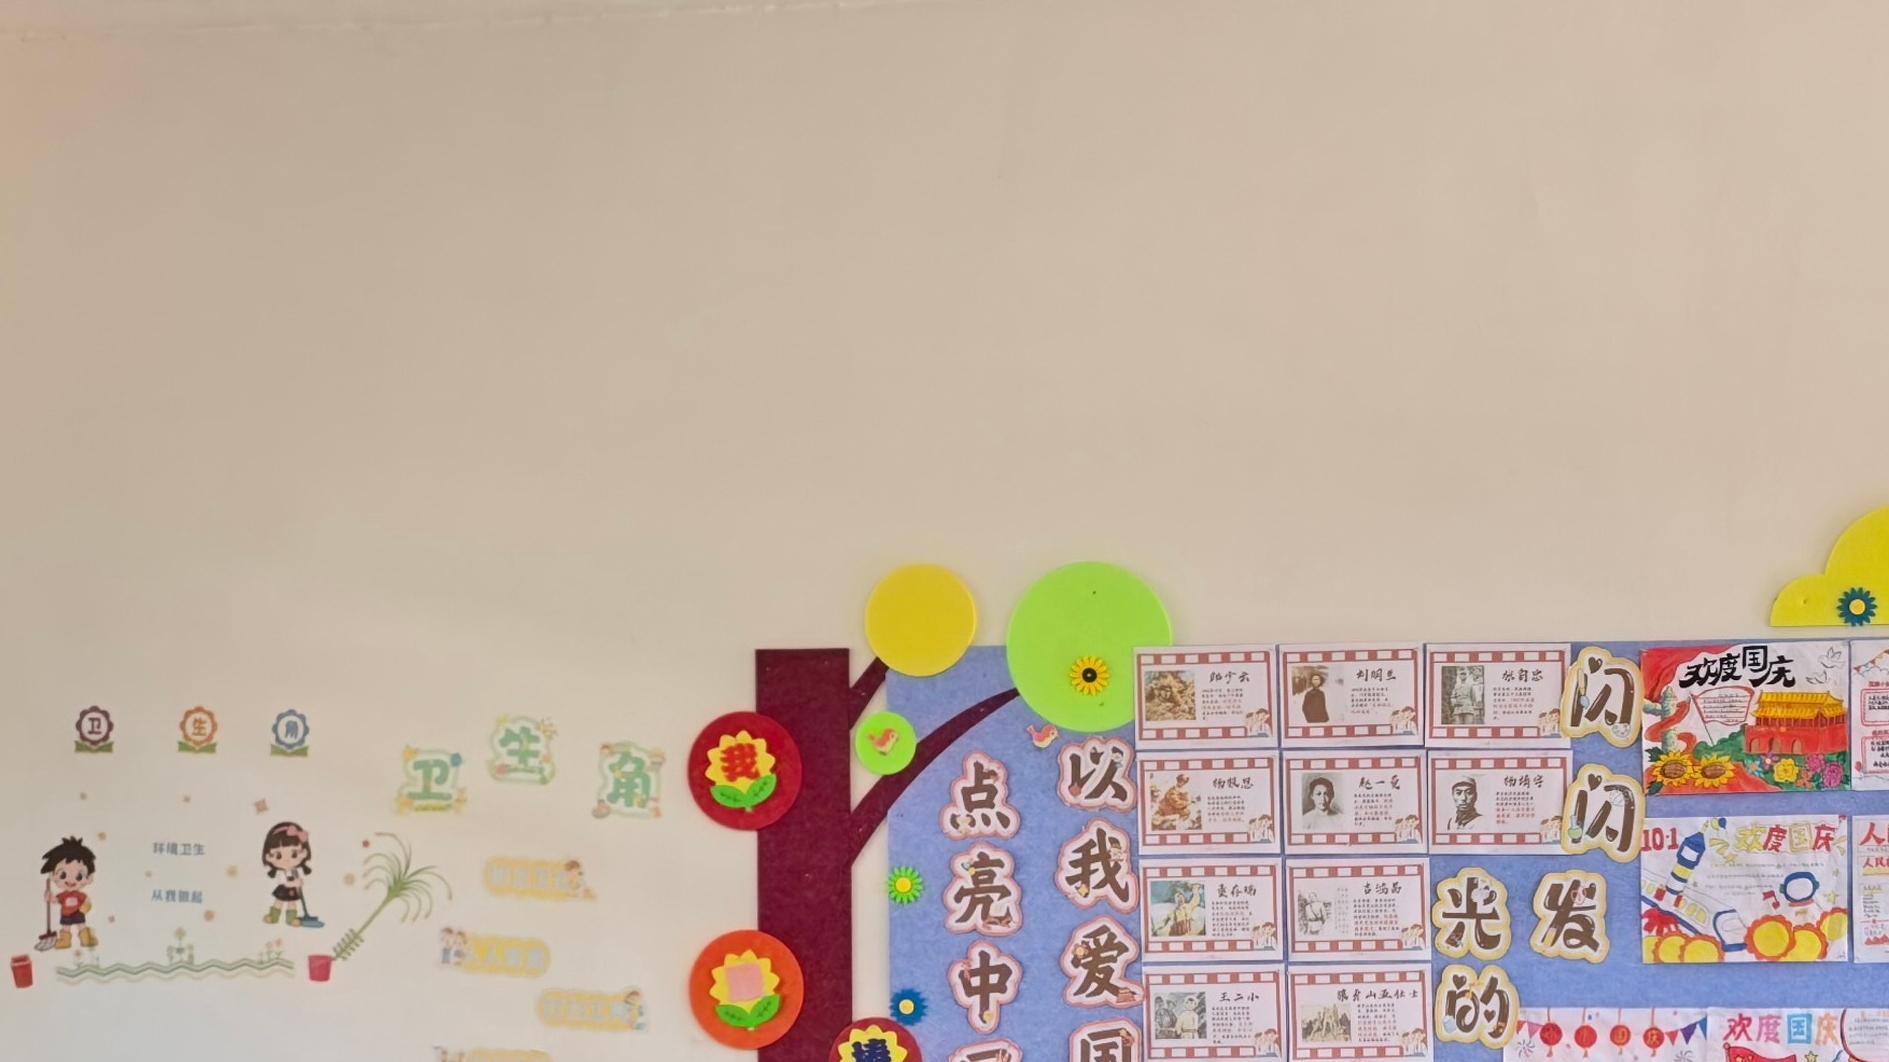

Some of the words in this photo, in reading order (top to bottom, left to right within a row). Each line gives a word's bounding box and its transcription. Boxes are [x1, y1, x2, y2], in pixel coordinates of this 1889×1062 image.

[1679, 645, 1796, 688] 欢度国庆
[720, 743, 758, 781] 我
[1217, 991, 1260, 1004] 王二小
[1723, 1012, 1840, 1046] 欢度国庆
